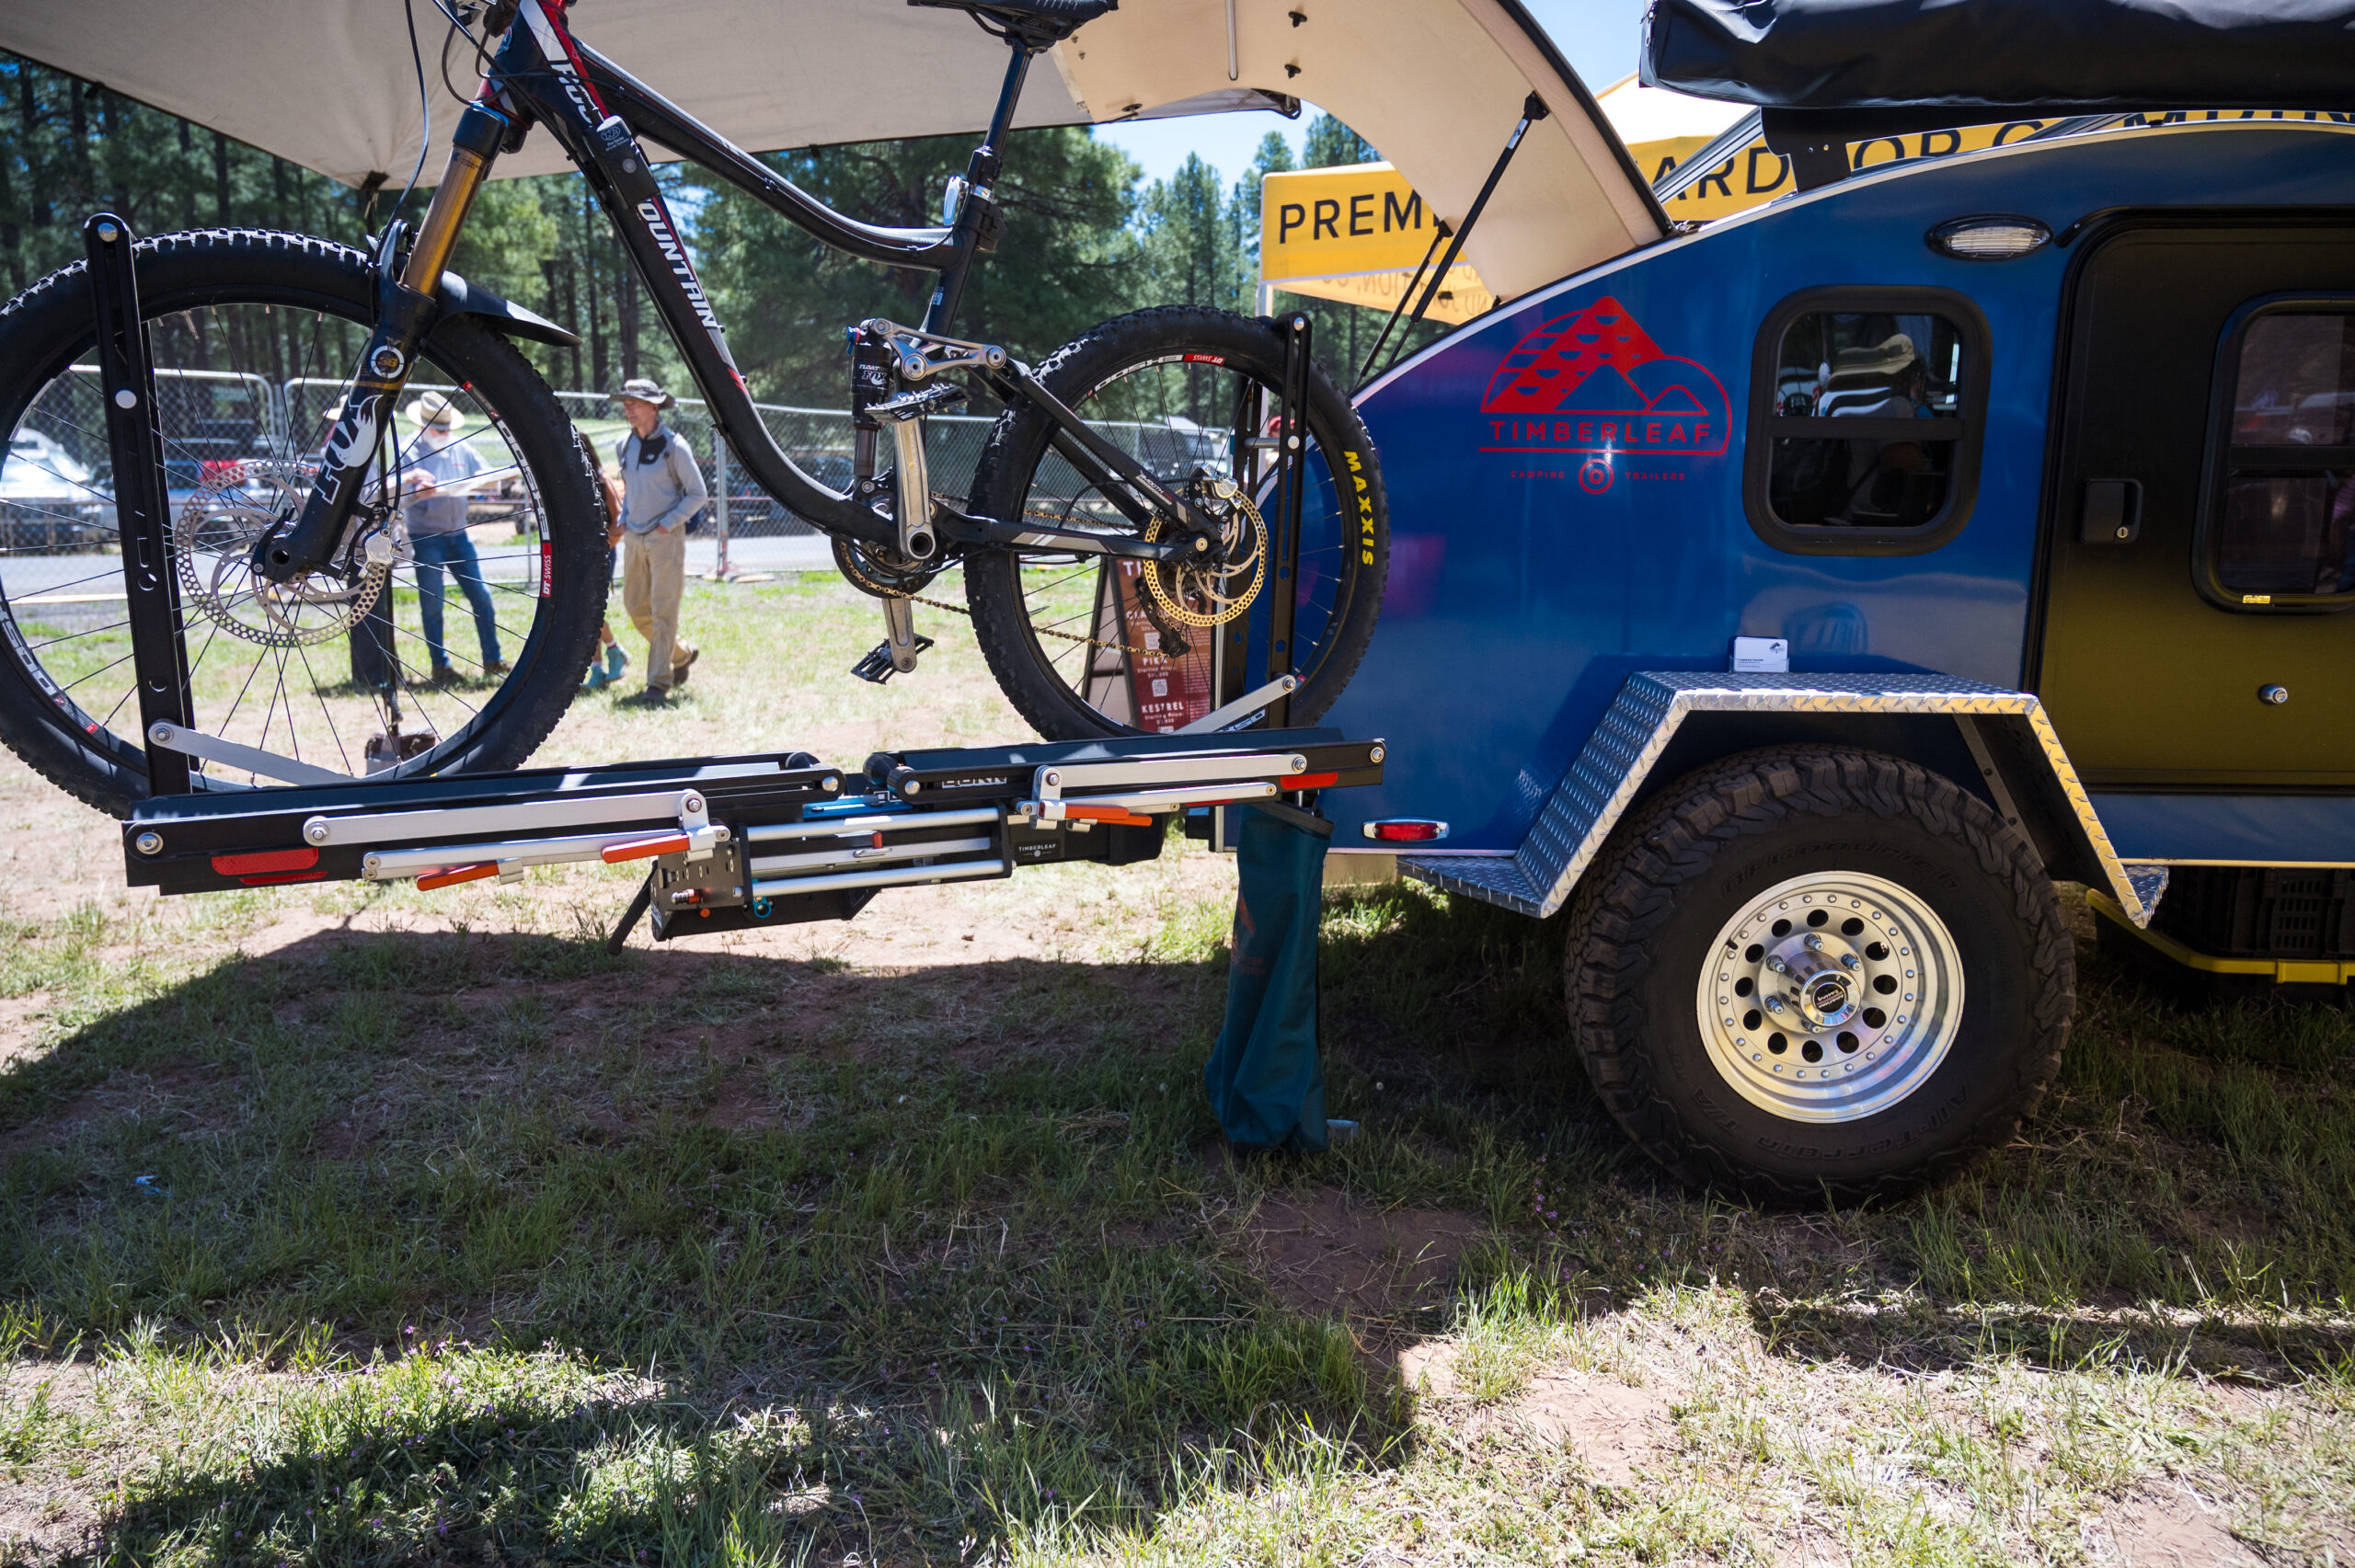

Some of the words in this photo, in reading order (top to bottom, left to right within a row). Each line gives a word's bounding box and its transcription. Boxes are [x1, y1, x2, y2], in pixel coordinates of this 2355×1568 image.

[637, 199, 718, 328] OUNTAIN
[861, 370, 888, 385] FOX
[1489, 420, 1710, 443] TIMBERLEAF
[314, 394, 384, 505] FOX
[1511, 470, 1565, 479] CAMPING
[1626, 472, 1685, 481] TRAILERS
[1344, 451, 1374, 566] MAXXIS
[544, 555, 552, 579] SWISS
[543, 581, 550, 595] DT
[1143, 657, 1168, 666] PIKA
[1142, 701, 1185, 714] KESTREL
[1018, 843, 1057, 853] TIMBERLEAF
